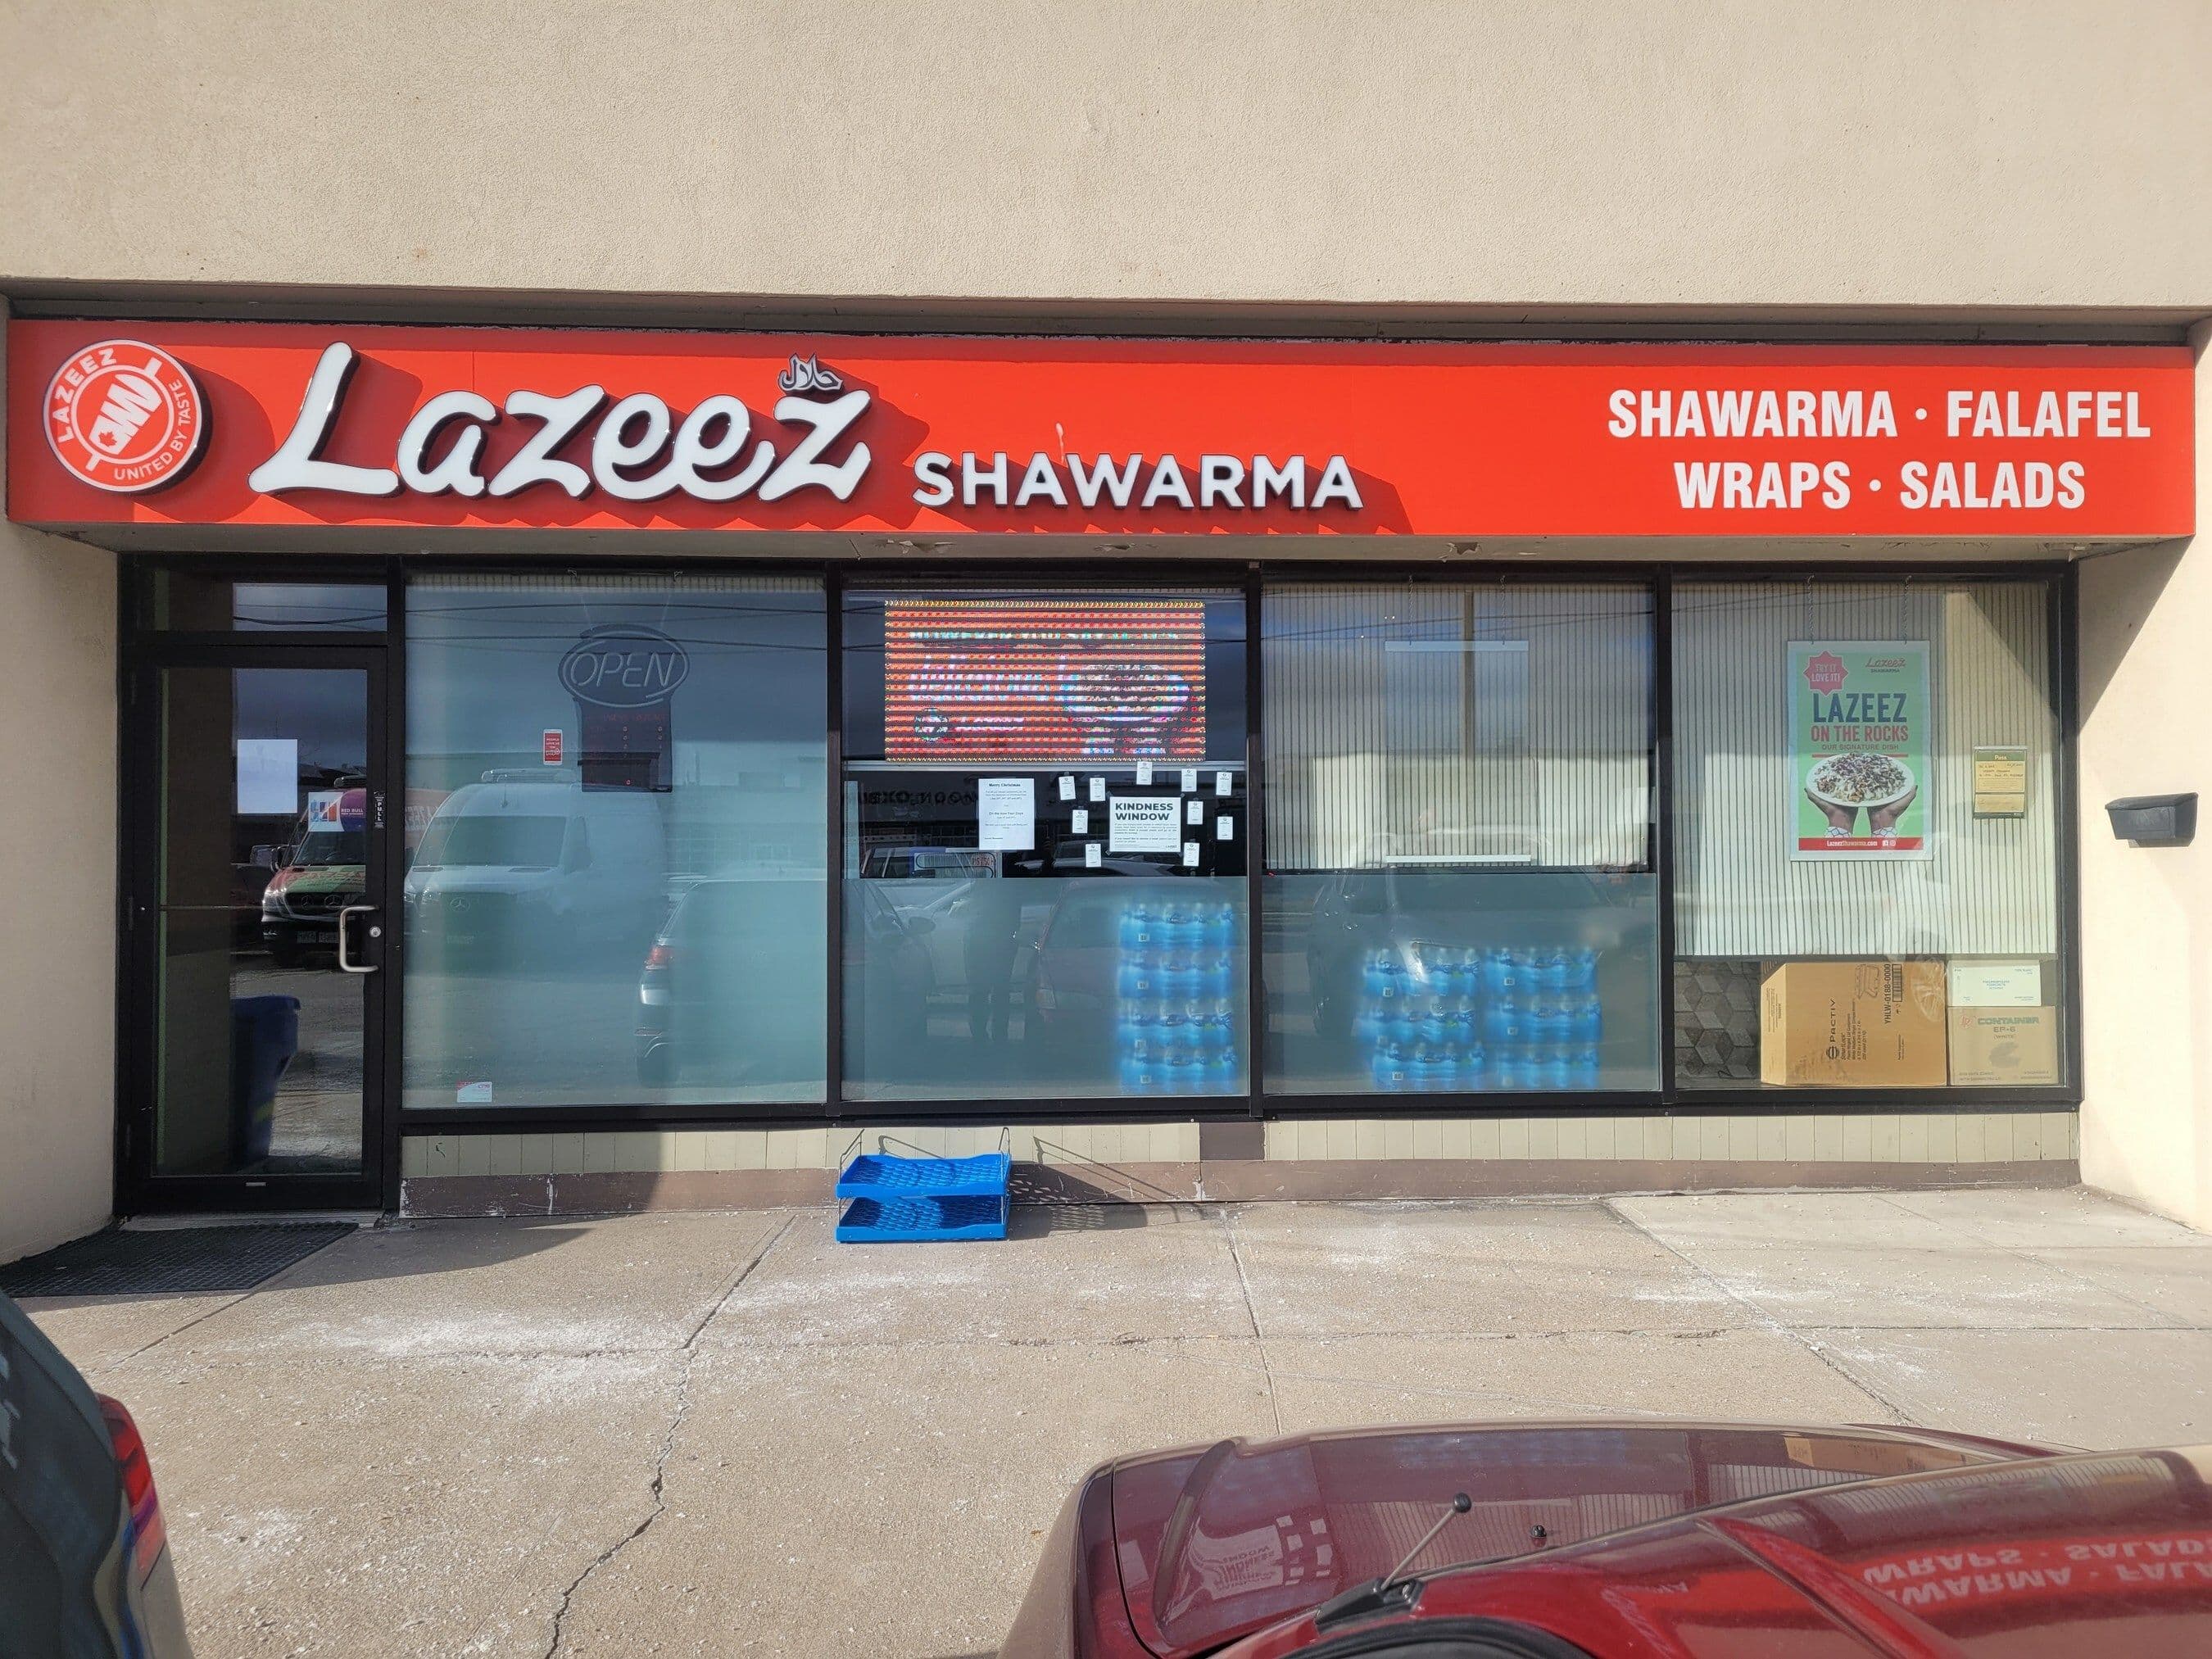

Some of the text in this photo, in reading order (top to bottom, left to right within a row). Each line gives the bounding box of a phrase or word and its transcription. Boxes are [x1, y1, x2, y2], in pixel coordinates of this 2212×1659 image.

[779, 355, 842, 390] حلال
[52, 348, 117, 443] LAZEEZ
[113, 378, 192, 481] UNITED BY TASTE
[247, 341, 872, 503] Lazeez
[1607, 388, 2151, 439] SHAWARMA FALAFEL
[913, 451, 1364, 509] SHAWARMA
[1673, 460, 2086, 510] WRAPS SALADS
[570, 652, 675, 687] OPEN
[1811, 673, 1829, 682] LOVE
[1865, 656, 1906, 668] Lazeez
[1813, 693, 1907, 723] LAZEEZ
[1811, 725, 1909, 742] ON THE ROCKS
[1115, 803, 1173, 811] KINDNESS
[1115, 813, 1170, 821] WINDOW
